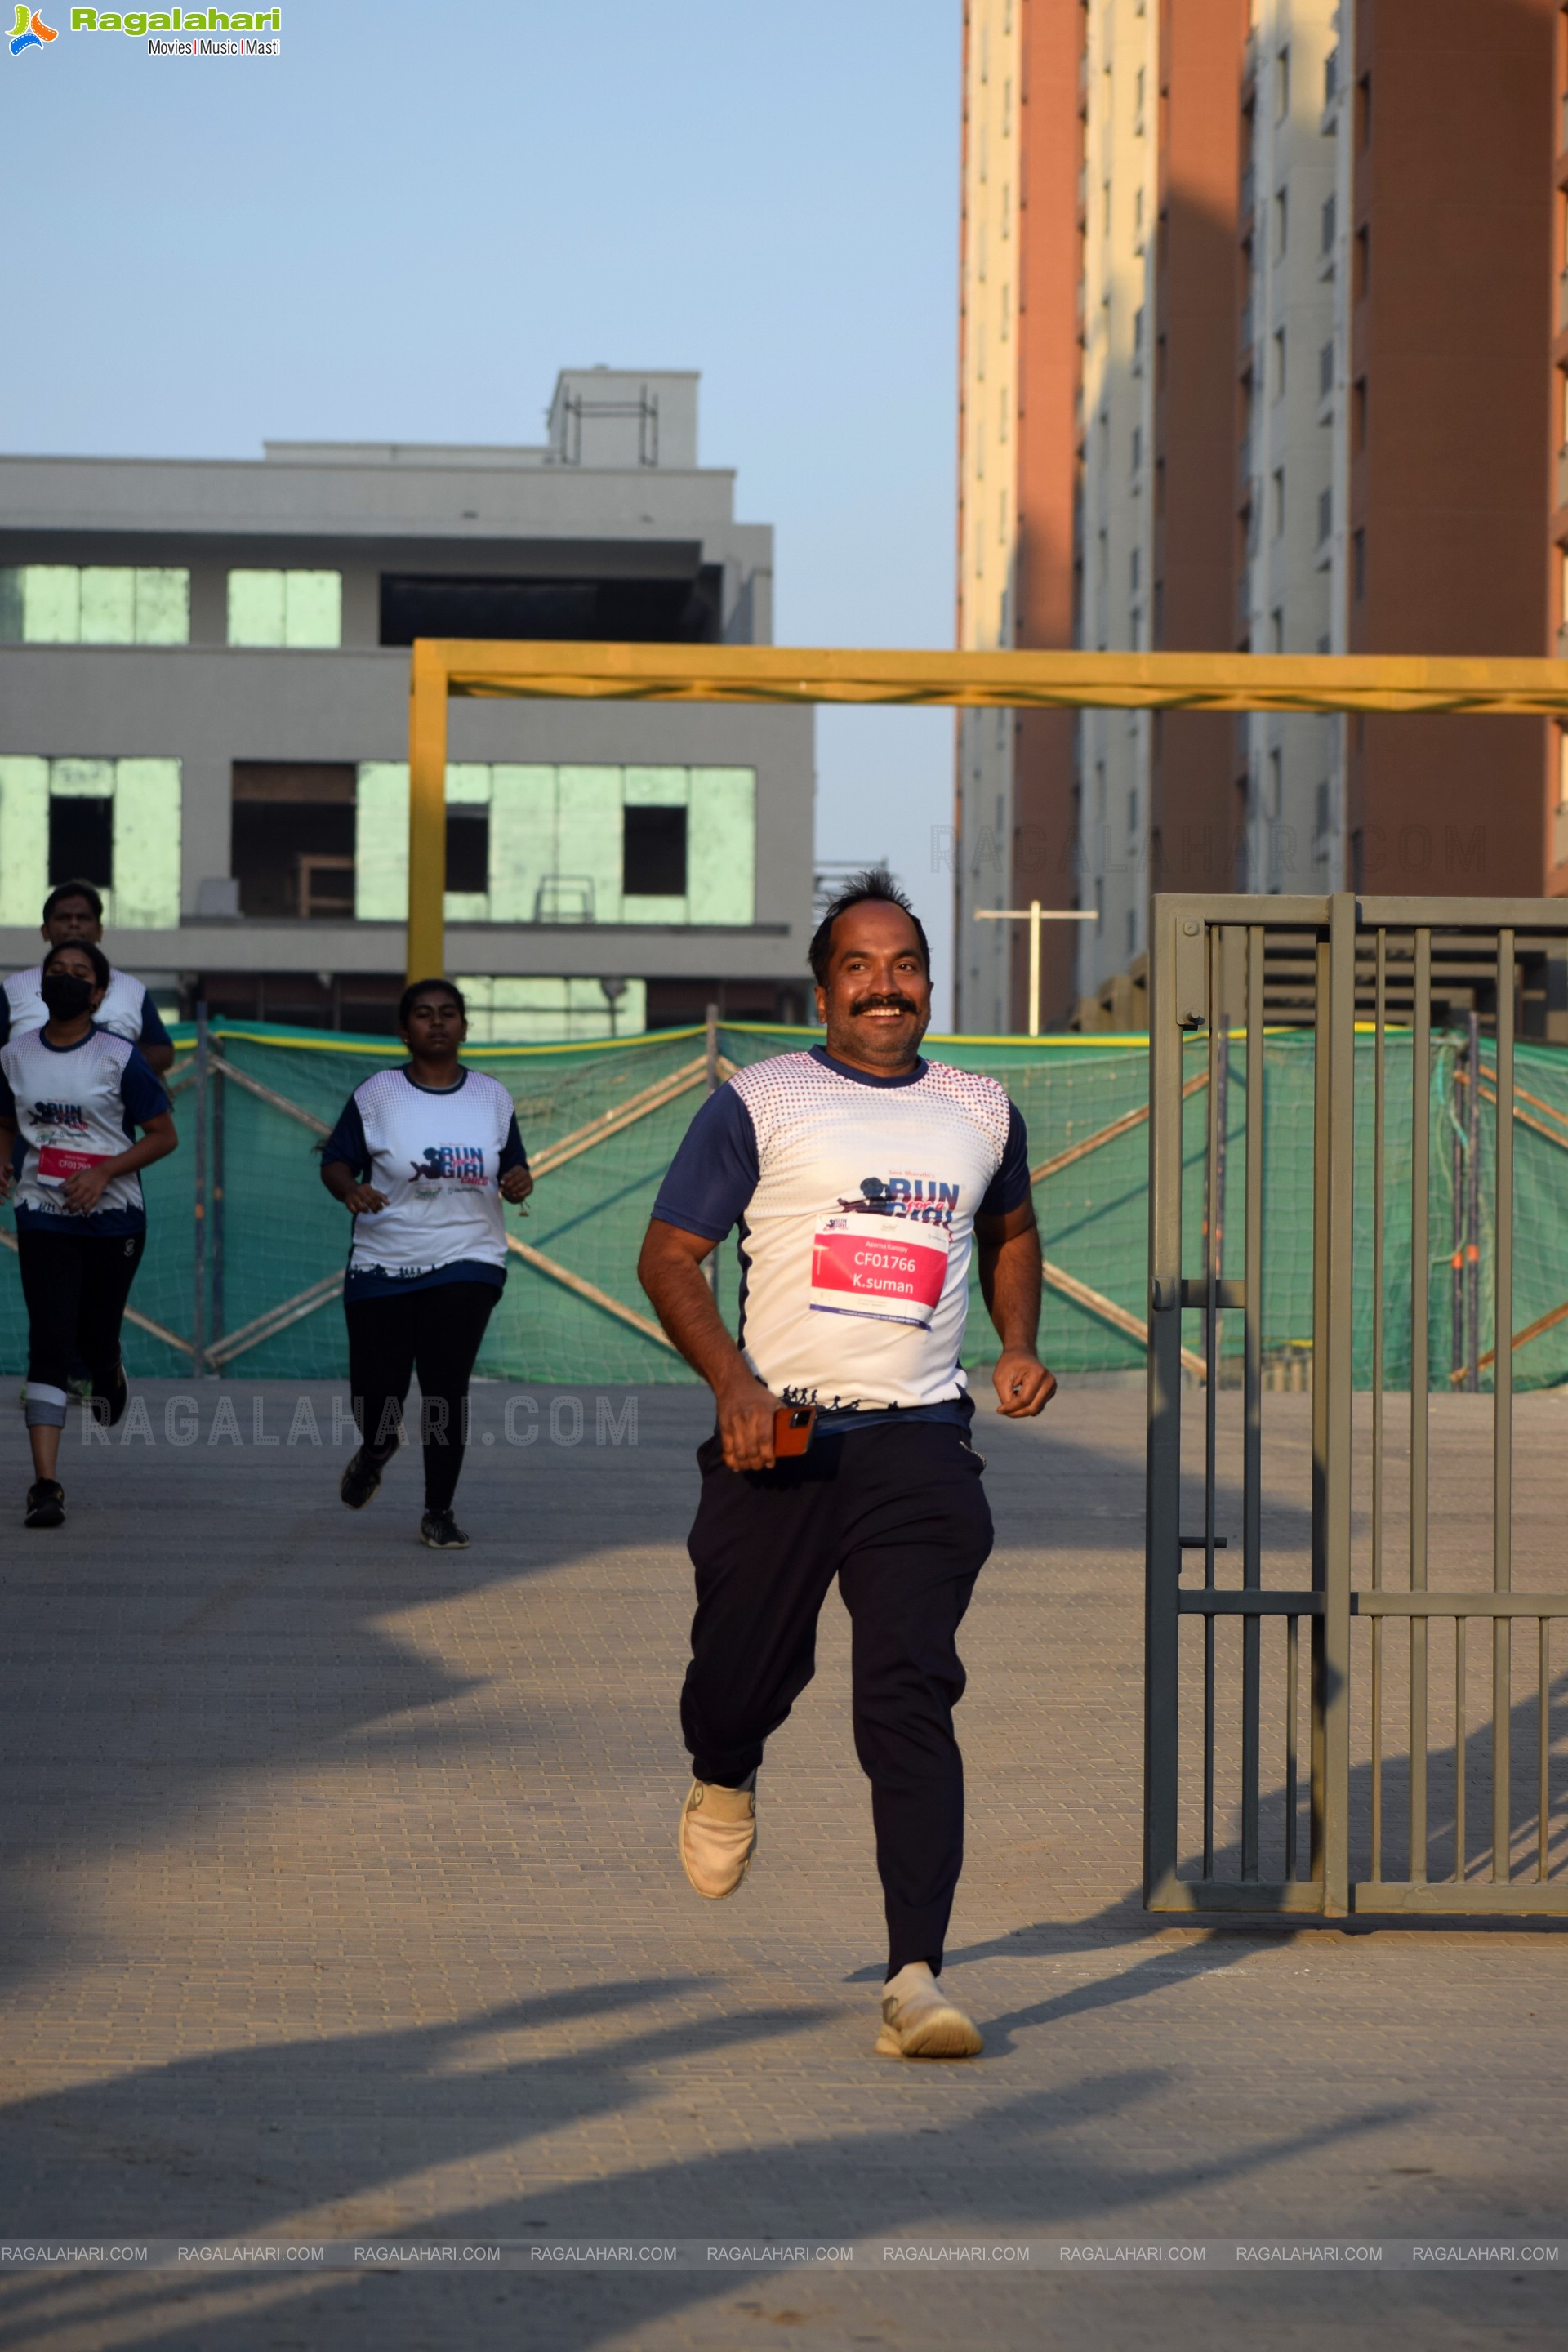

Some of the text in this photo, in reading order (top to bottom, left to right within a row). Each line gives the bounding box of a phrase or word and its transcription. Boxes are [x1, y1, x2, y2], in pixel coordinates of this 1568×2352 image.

[440, 1147, 484, 1163] RUN
[441, 1162, 486, 1178] GIRL
[889, 1178, 960, 1211] RUN
[906, 1200, 946, 1214] for a
[865, 1241, 908, 1254] Aparna Kanopy
[854, 1251, 915, 1272] CF01766
[853, 1272, 914, 1294] K.suman
